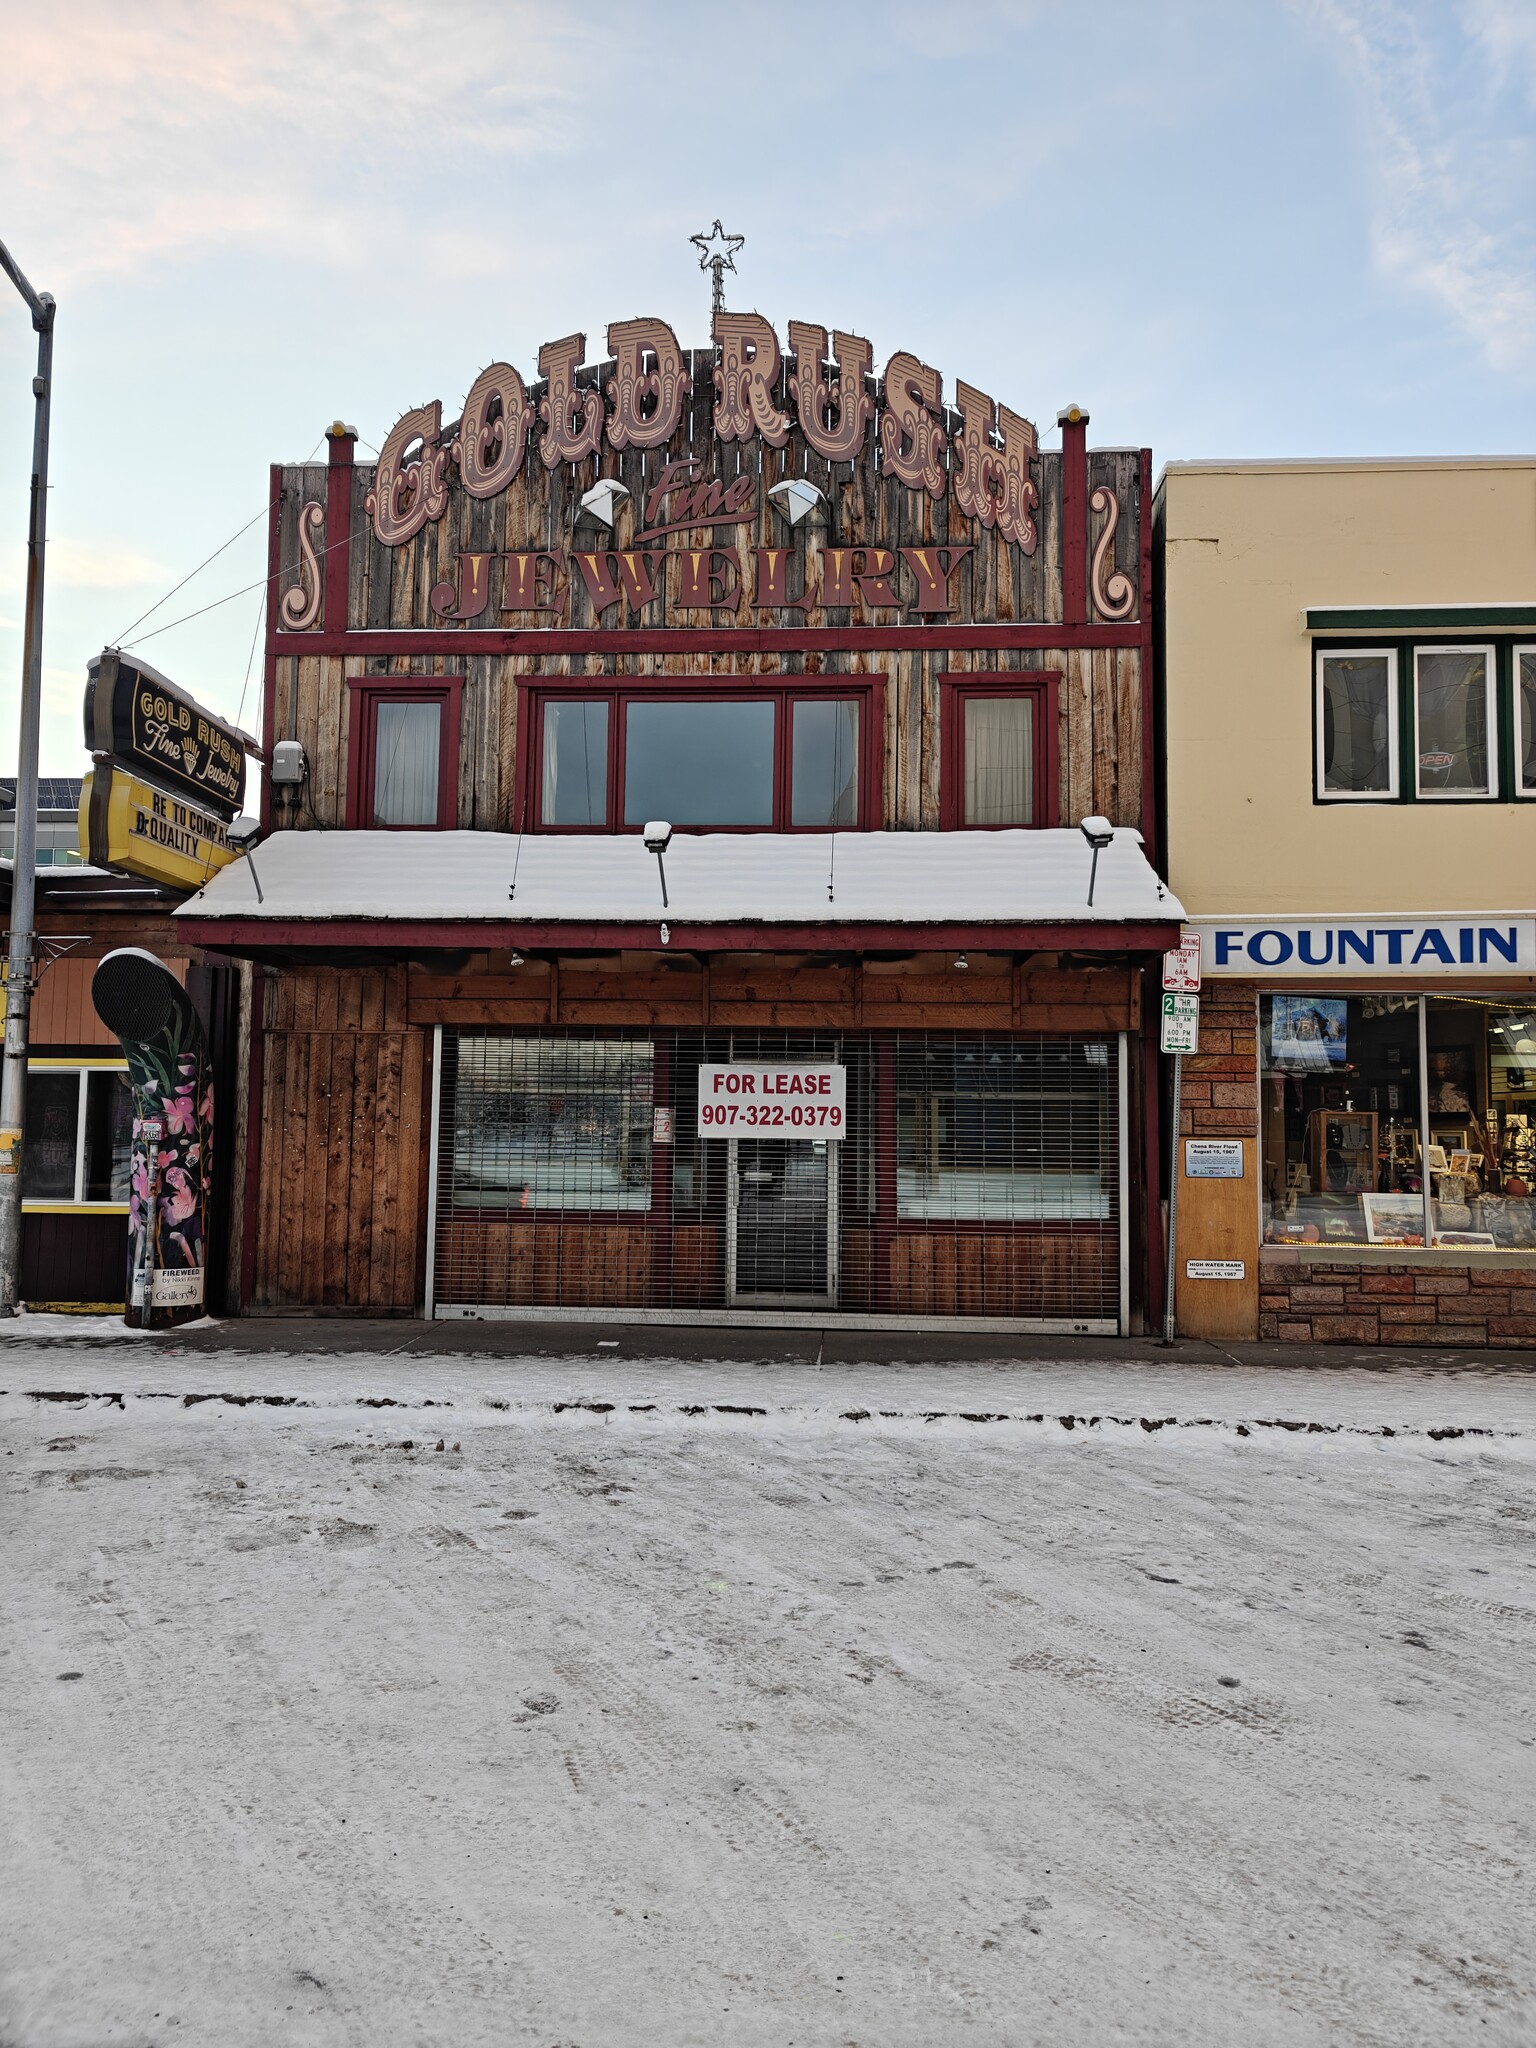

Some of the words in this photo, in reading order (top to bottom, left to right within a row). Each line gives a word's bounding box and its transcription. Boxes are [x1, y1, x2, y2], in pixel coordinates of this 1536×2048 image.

[363, 317, 692, 546] GOLD
[712, 312, 1038, 556] RUSH
[644, 458, 756, 522] Fine
[431, 546, 975, 619] JEWELRY
[140, 692, 191, 732] GOLD
[197, 719, 241, 774] RUSH
[143, 720, 181, 760] Fine
[196, 750, 240, 799] Jewelry
[1419, 755, 1454, 765] OPEN
[153, 793, 167, 818] RE
[173, 803, 186, 826] TO
[151, 817, 199, 857] QUALITY
[1170, 950, 1195, 958] MONDAY
[1215, 927, 1517, 965] FOUNTAIN
[1165, 997, 1173, 1012] 2
[1175, 1007, 1196, 1015] PARKING
[713, 1074, 756, 1094] FOR
[762, 1074, 831, 1095] LEASE
[702, 1104, 842, 1126] 907-322-0379
[162, 1268, 200, 1276] FIREWEED
[156, 1290, 188, 1303] Gallery
